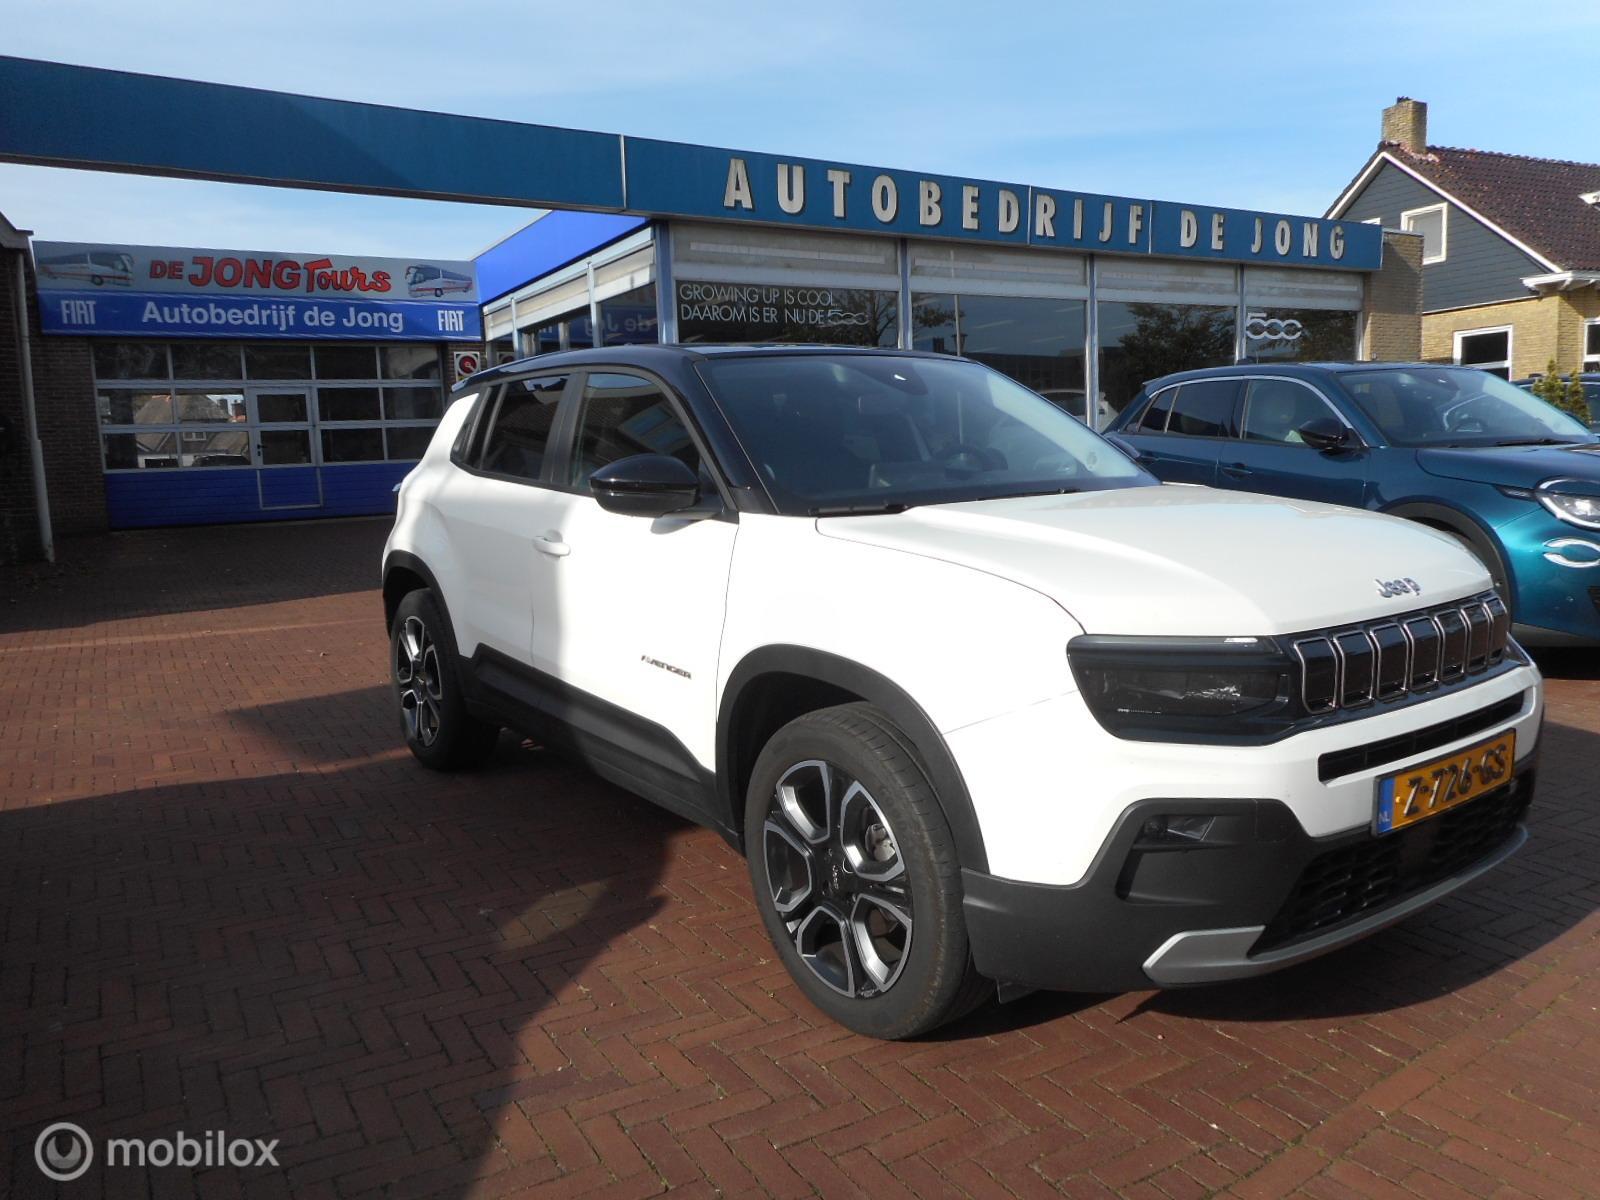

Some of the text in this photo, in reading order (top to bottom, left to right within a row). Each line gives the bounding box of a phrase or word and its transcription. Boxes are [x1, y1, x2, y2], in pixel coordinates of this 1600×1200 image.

[723, 157, 1345, 260] AUTOBEDRIJF DE JONG
[150, 256, 392, 293] DE JONG Tours
[679, 284, 759, 304] GROWING
[763, 287, 780, 304] UP
[784, 289, 795, 305] IS
[61, 299, 96, 325] FIAT
[142, 301, 403, 332] Autobedrijf de Jong
[437, 309, 464, 331] FIAT
[680, 303, 870, 326] DAAROM IS ER NU DE 500
[1245, 312, 1303, 340] 500
[1374, 577, 1421, 598] Jeep
